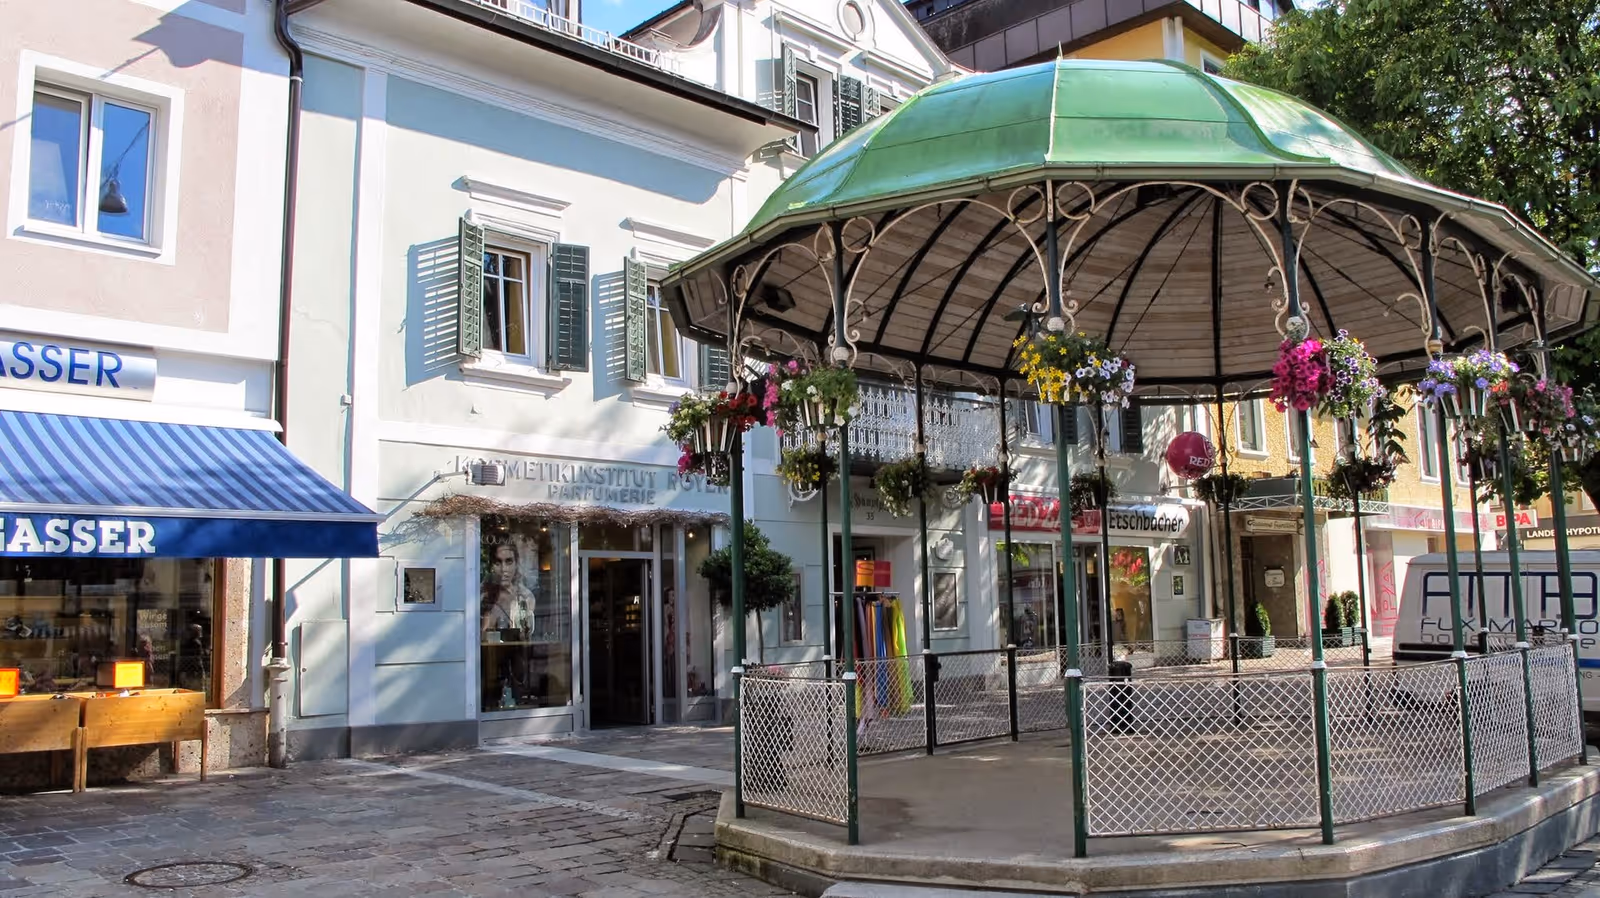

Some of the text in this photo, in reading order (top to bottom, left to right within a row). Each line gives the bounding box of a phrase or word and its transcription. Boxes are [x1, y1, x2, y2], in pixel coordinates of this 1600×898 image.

[0, 341, 123, 389] SSER
[456, 455, 656, 489] KMETIKINSTITUT
[1108, 509, 1184, 533] Etschbacher
[1496, 512, 1532, 528] BPA
[0, 517, 156, 554] ASSER
[1420, 617, 1599, 636] FUX MARO
